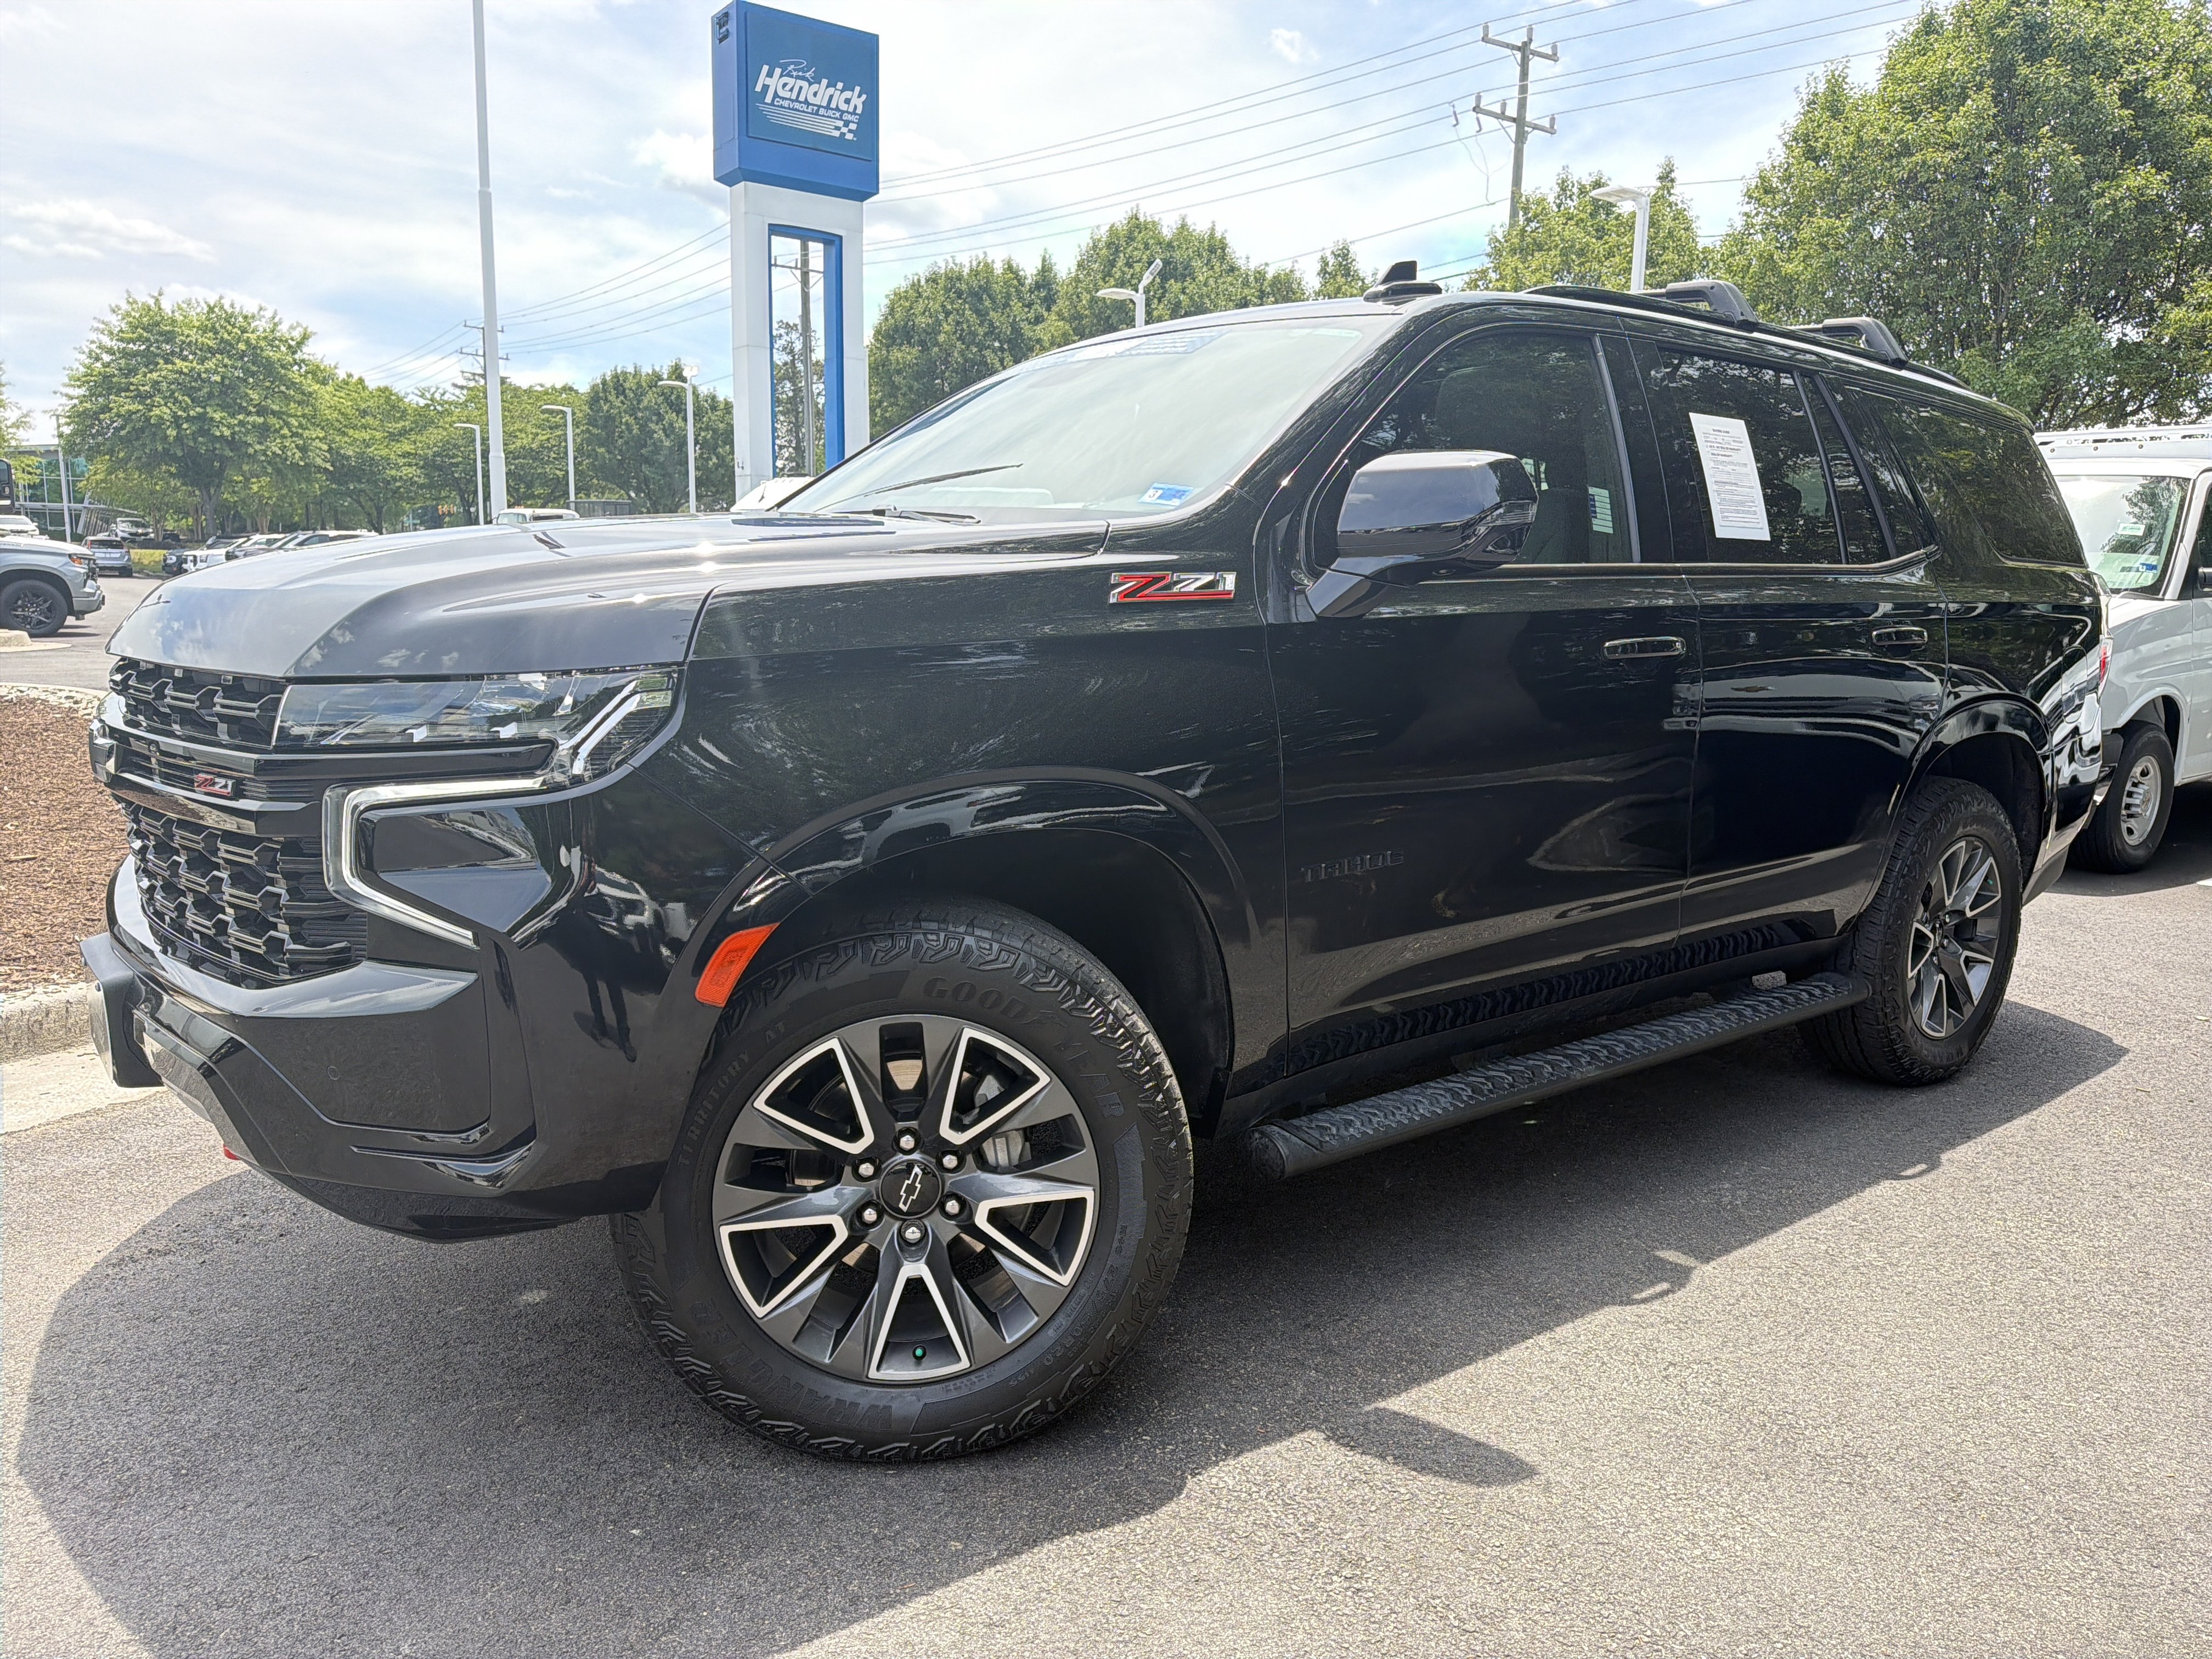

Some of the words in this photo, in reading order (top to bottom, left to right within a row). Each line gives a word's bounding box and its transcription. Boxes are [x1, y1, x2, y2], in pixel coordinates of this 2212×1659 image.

[780, 59, 815, 82] Rick
[755, 65, 867, 114] Hendrick
[774, 98, 817, 113] CHEVROLET
[819, 108, 840, 119] BUICK
[843, 113, 860, 122] GMC
[1109, 572, 1237, 603] Z71
[194, 772, 236, 796] Z71
[1300, 849, 1404, 882] TAHOE
[678, 1048, 750, 1165] TERRITORY
